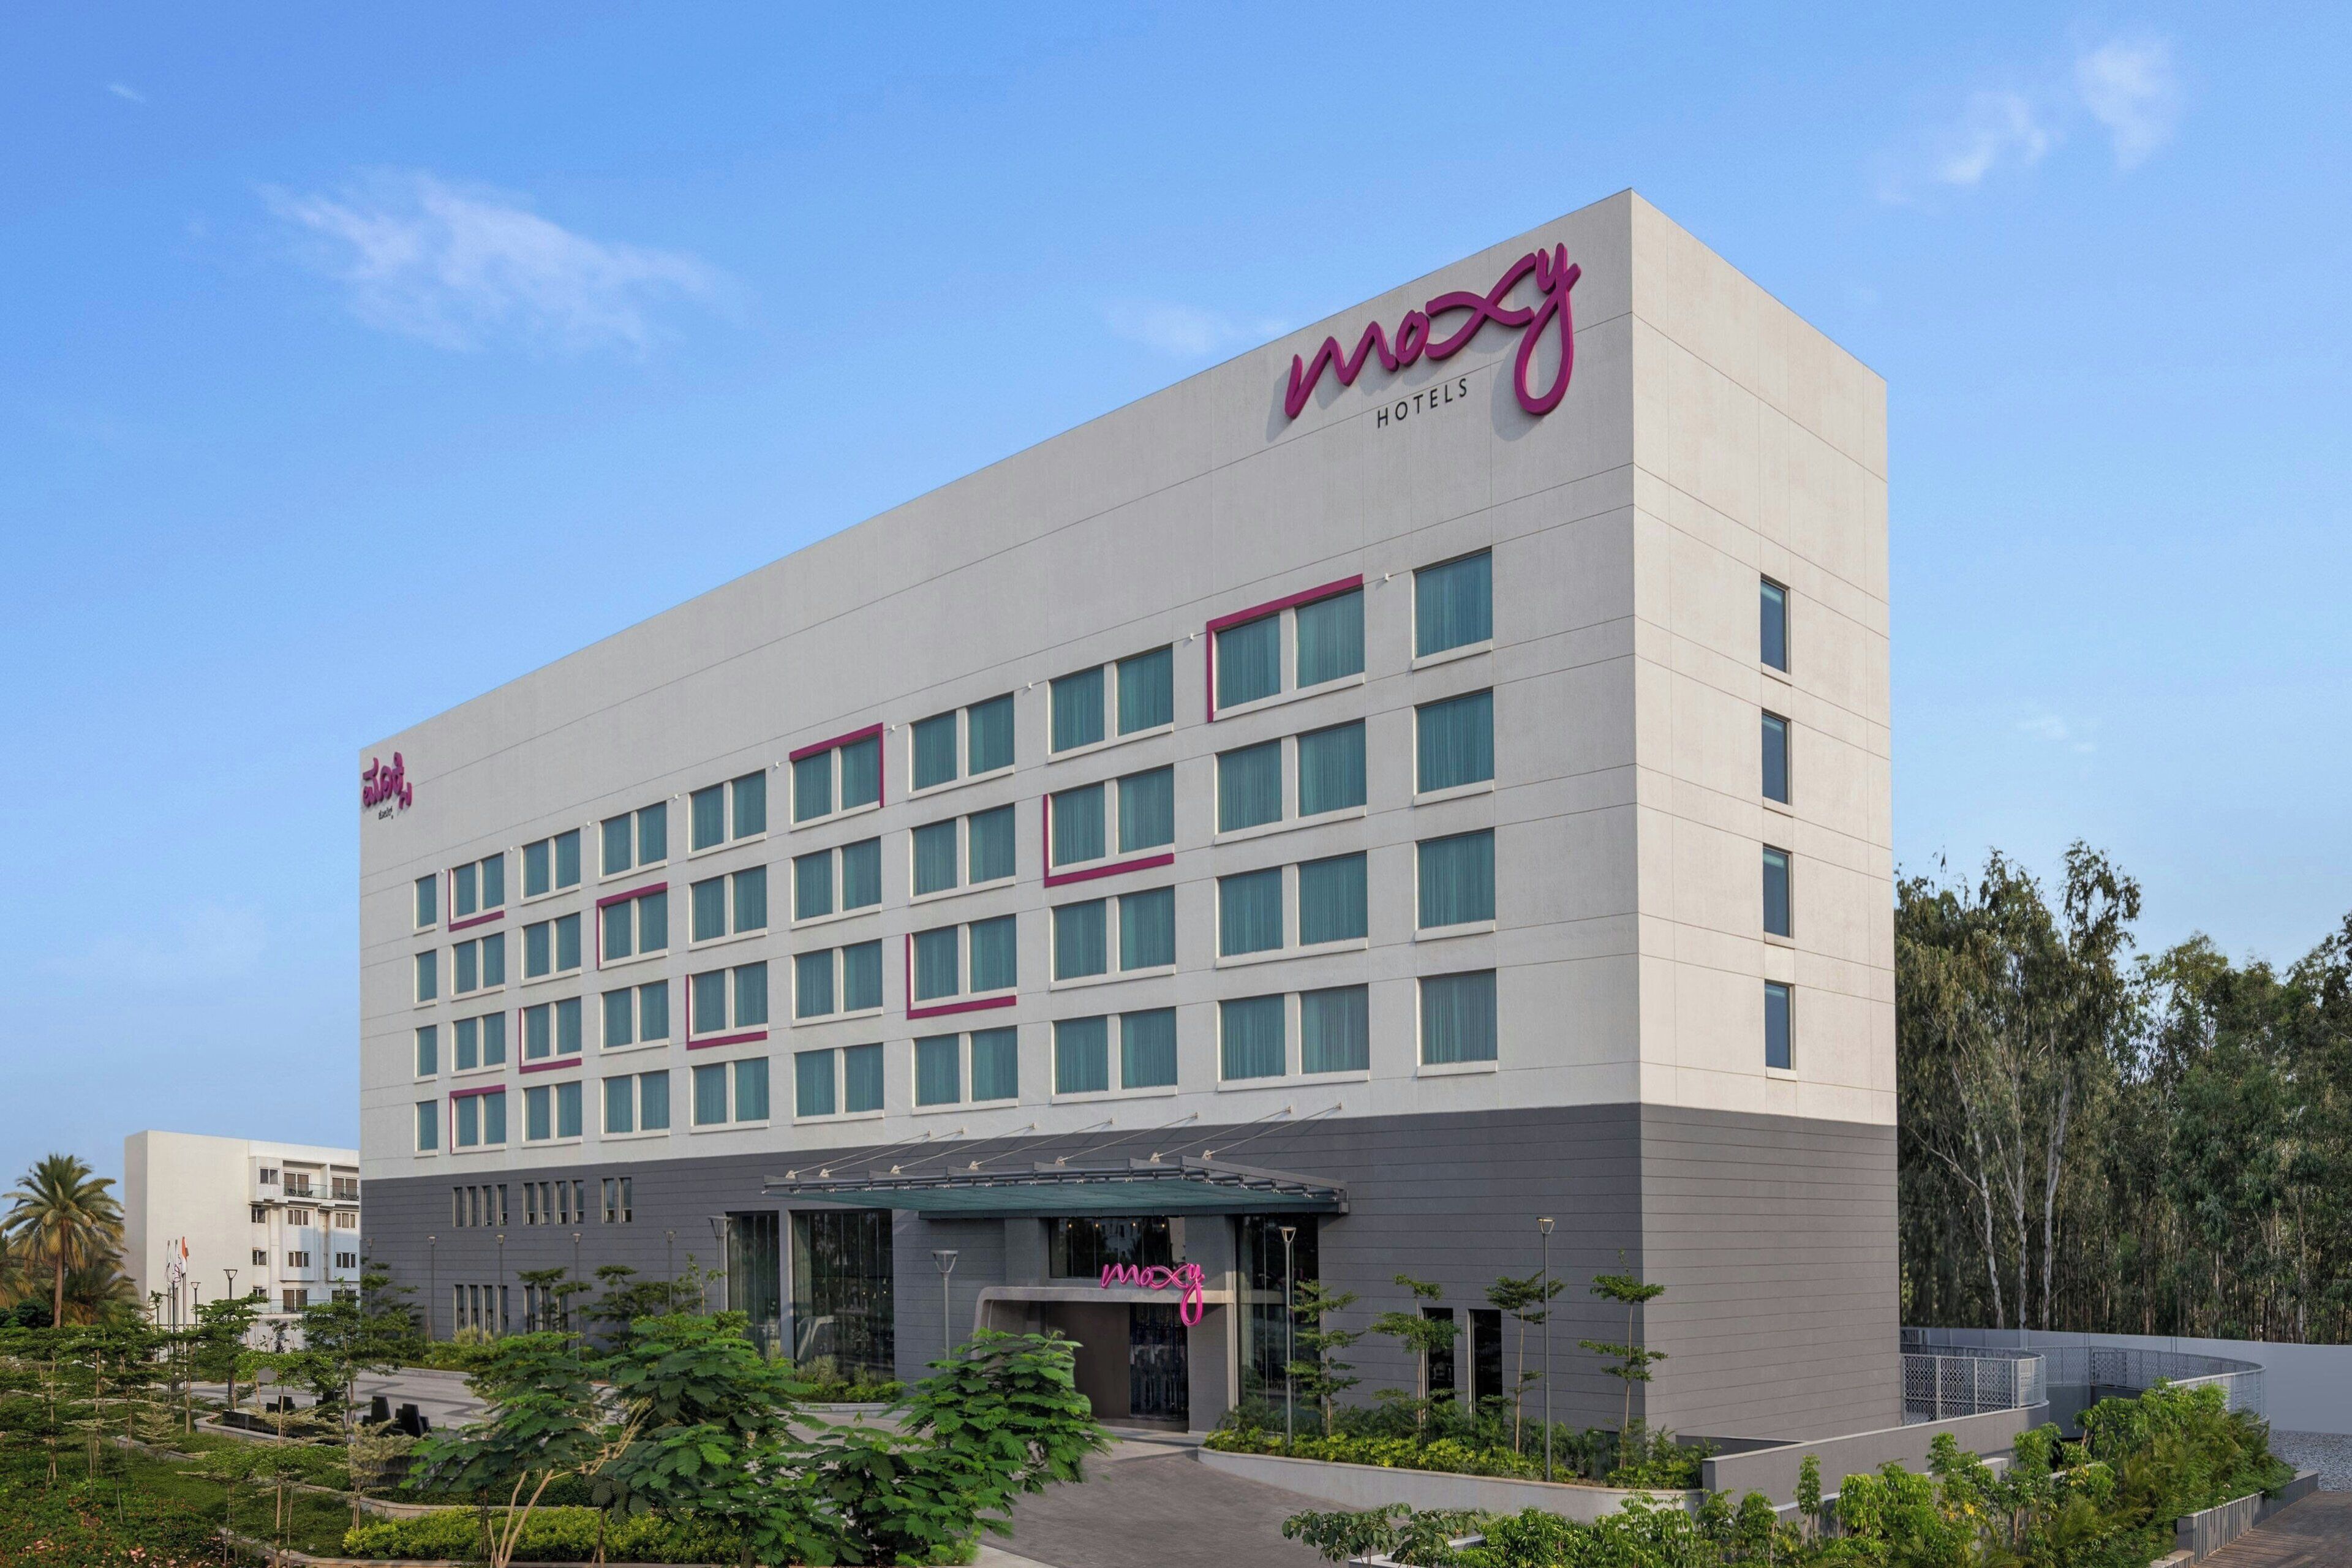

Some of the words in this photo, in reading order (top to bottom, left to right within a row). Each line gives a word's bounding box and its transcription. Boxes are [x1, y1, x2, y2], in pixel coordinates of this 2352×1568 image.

[1284, 243, 1581, 420] moxy
[1378, 378, 1467, 429] HOTELS
[1100, 1262, 1205, 1327] moxy
